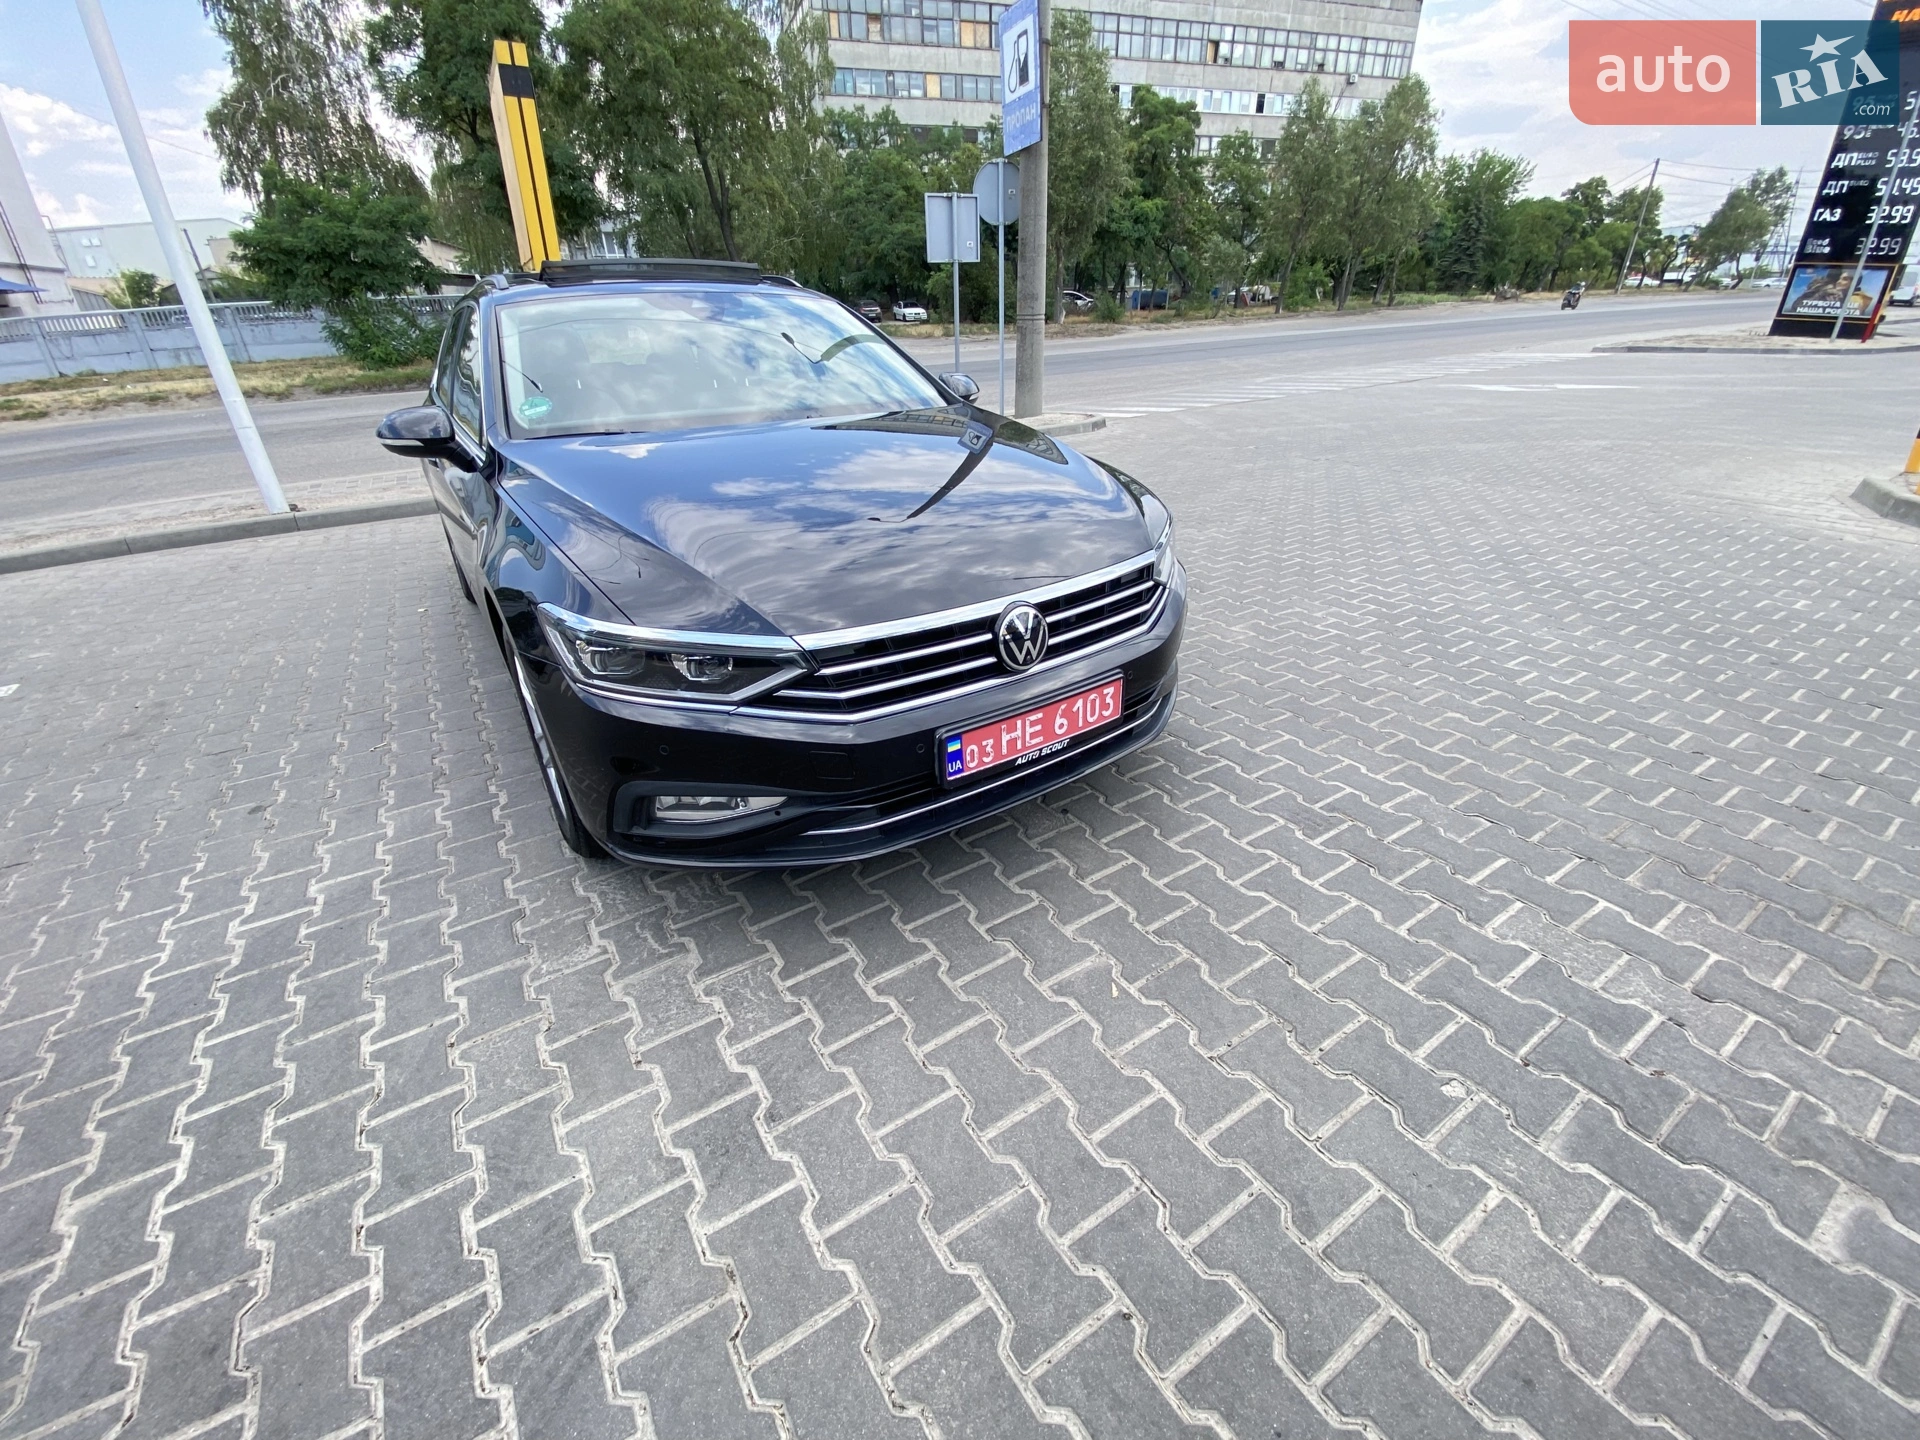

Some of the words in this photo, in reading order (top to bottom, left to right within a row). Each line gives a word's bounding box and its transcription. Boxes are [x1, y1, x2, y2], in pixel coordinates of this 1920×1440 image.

[1006, 102, 1036, 133] ПРОПАН
[1831, 153, 1858, 168] ДП
[1822, 180, 1849, 196] ДП
[1813, 208, 1842, 222] ГАЗ
[1865, 205, 1915, 224] 32.99
[1796, 306, 1823, 314] НАША
[1802, 299, 1841, 307] ТУРБОТА
[948, 760, 963, 773] UA
[966, 738, 994, 768] 03
[1001, 712, 1044, 756] HE
[1054, 686, 1115, 736] 6103
[1015, 750, 1040, 766] AUTO
[1040, 738, 1070, 757] SCOUT
